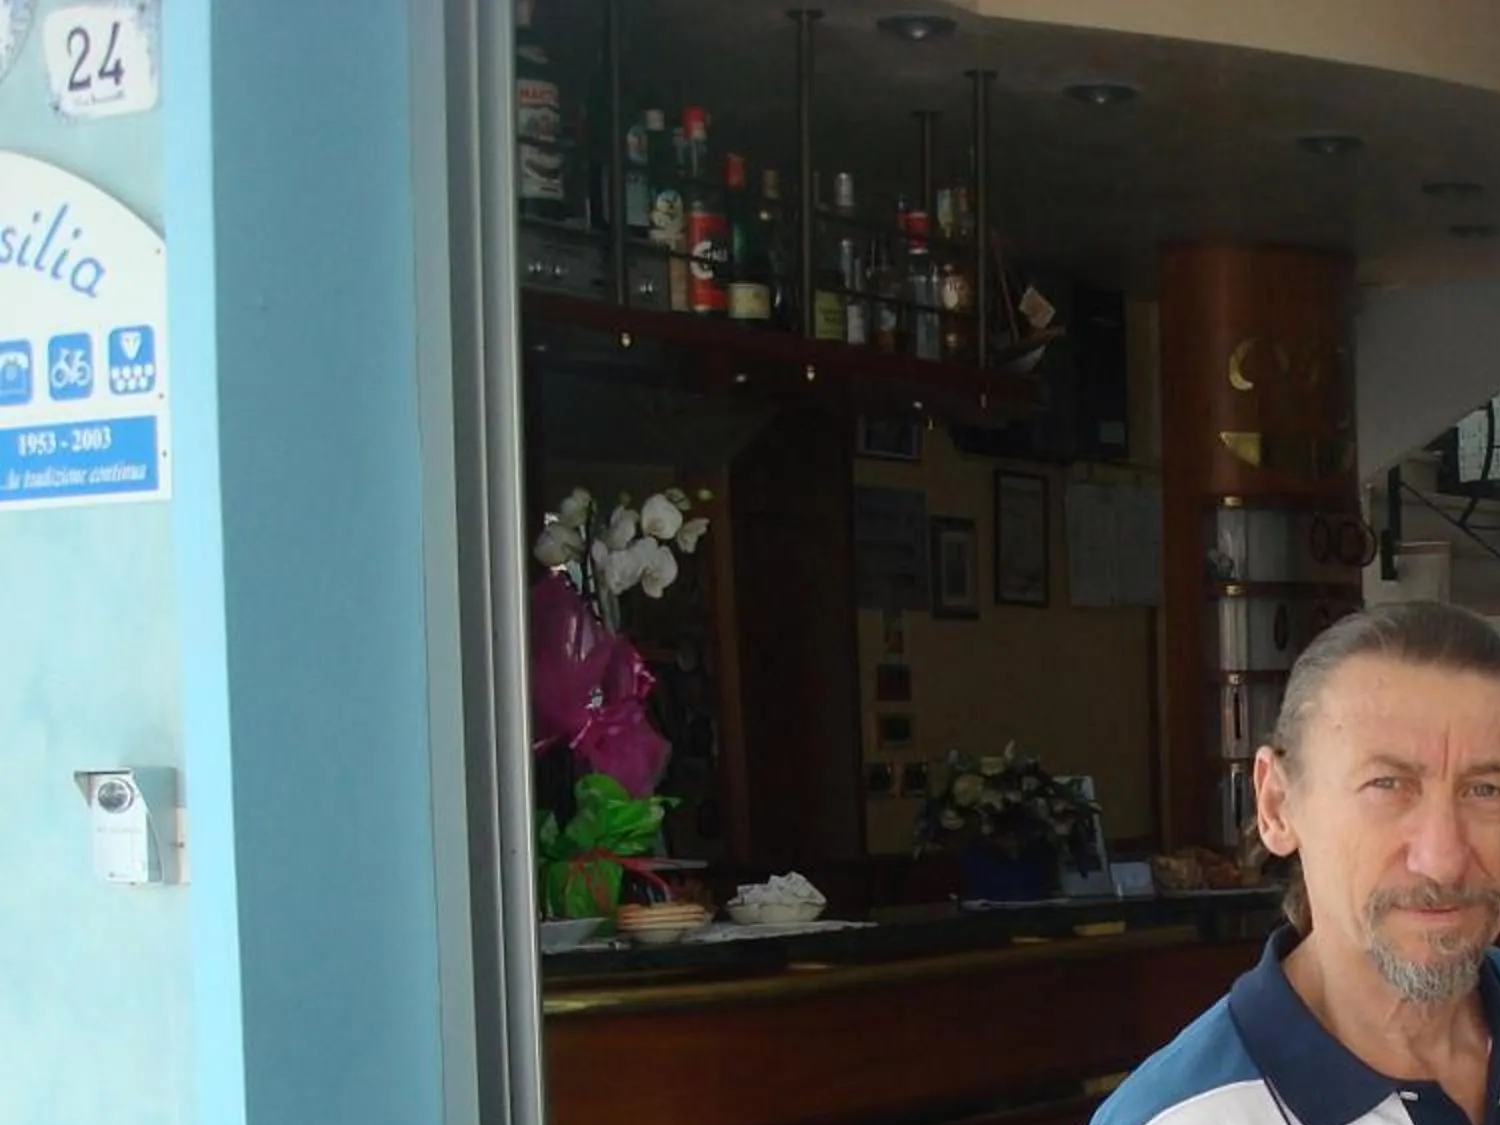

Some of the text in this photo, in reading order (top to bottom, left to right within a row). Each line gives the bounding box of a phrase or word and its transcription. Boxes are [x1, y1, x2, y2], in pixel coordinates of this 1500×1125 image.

[66, 20, 125, 91] 24
[18, 430, 57, 457] 1953
[71, 425, 112, 452] 2003
